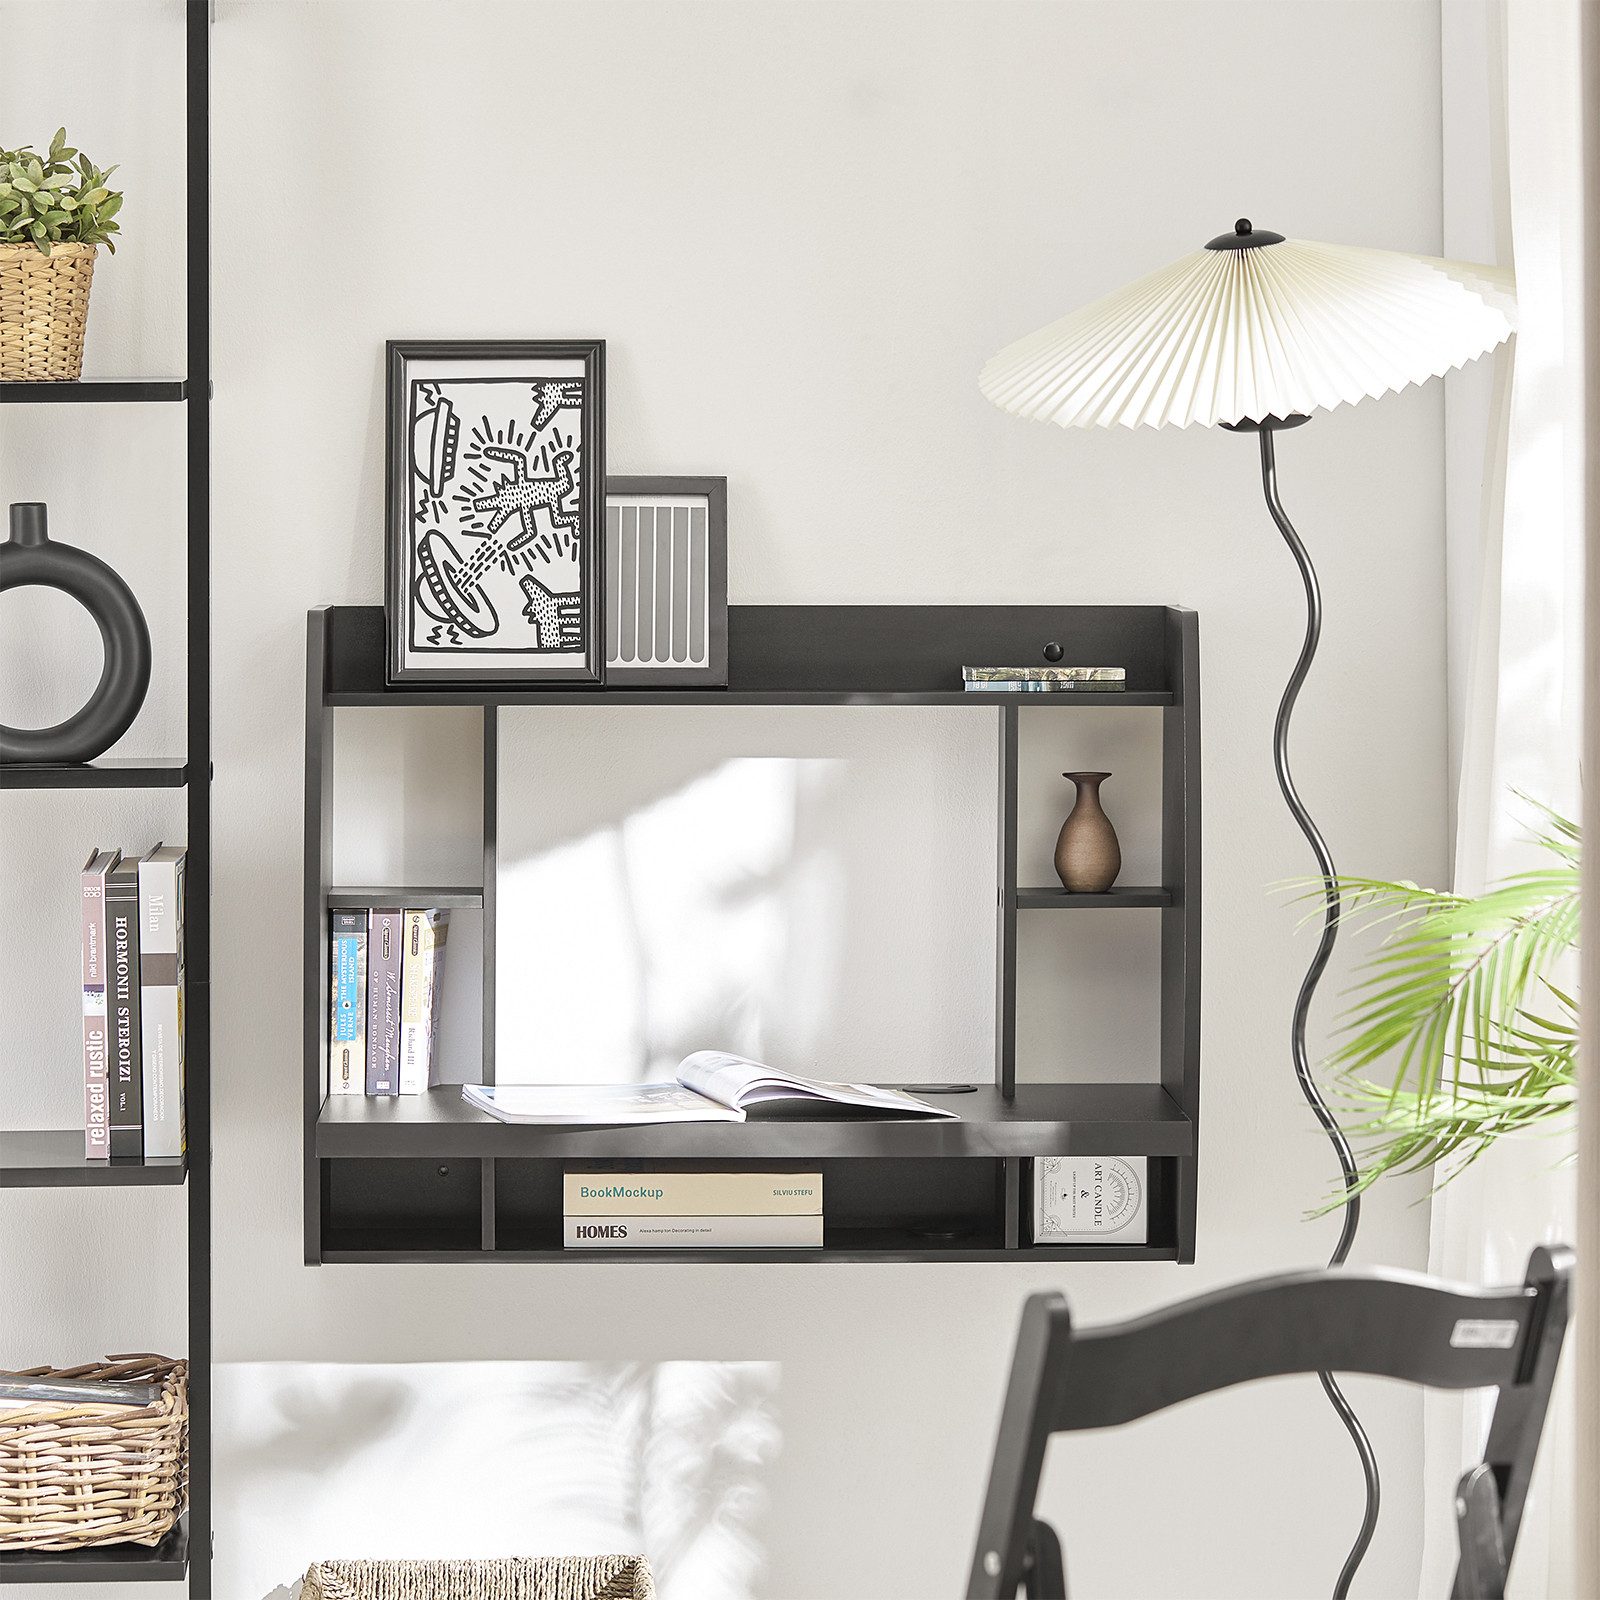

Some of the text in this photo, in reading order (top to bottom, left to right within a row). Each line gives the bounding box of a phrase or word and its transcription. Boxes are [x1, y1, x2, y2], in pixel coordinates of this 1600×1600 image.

[149, 894, 164, 933] Milan
[88, 922, 97, 963] brantmark
[373, 970, 379, 983] OF
[115, 916, 131, 1083] HORMONII STEROIZI
[385, 982, 397, 1026] Somerset
[86, 1030, 105, 1146] relaxed rustic
[580, 1186, 664, 1200] BookMockup
[1080, 1189, 1090, 1199] &
[1094, 1162, 1103, 1227] ART CANDLE
[576, 1225, 628, 1239] HOMES
